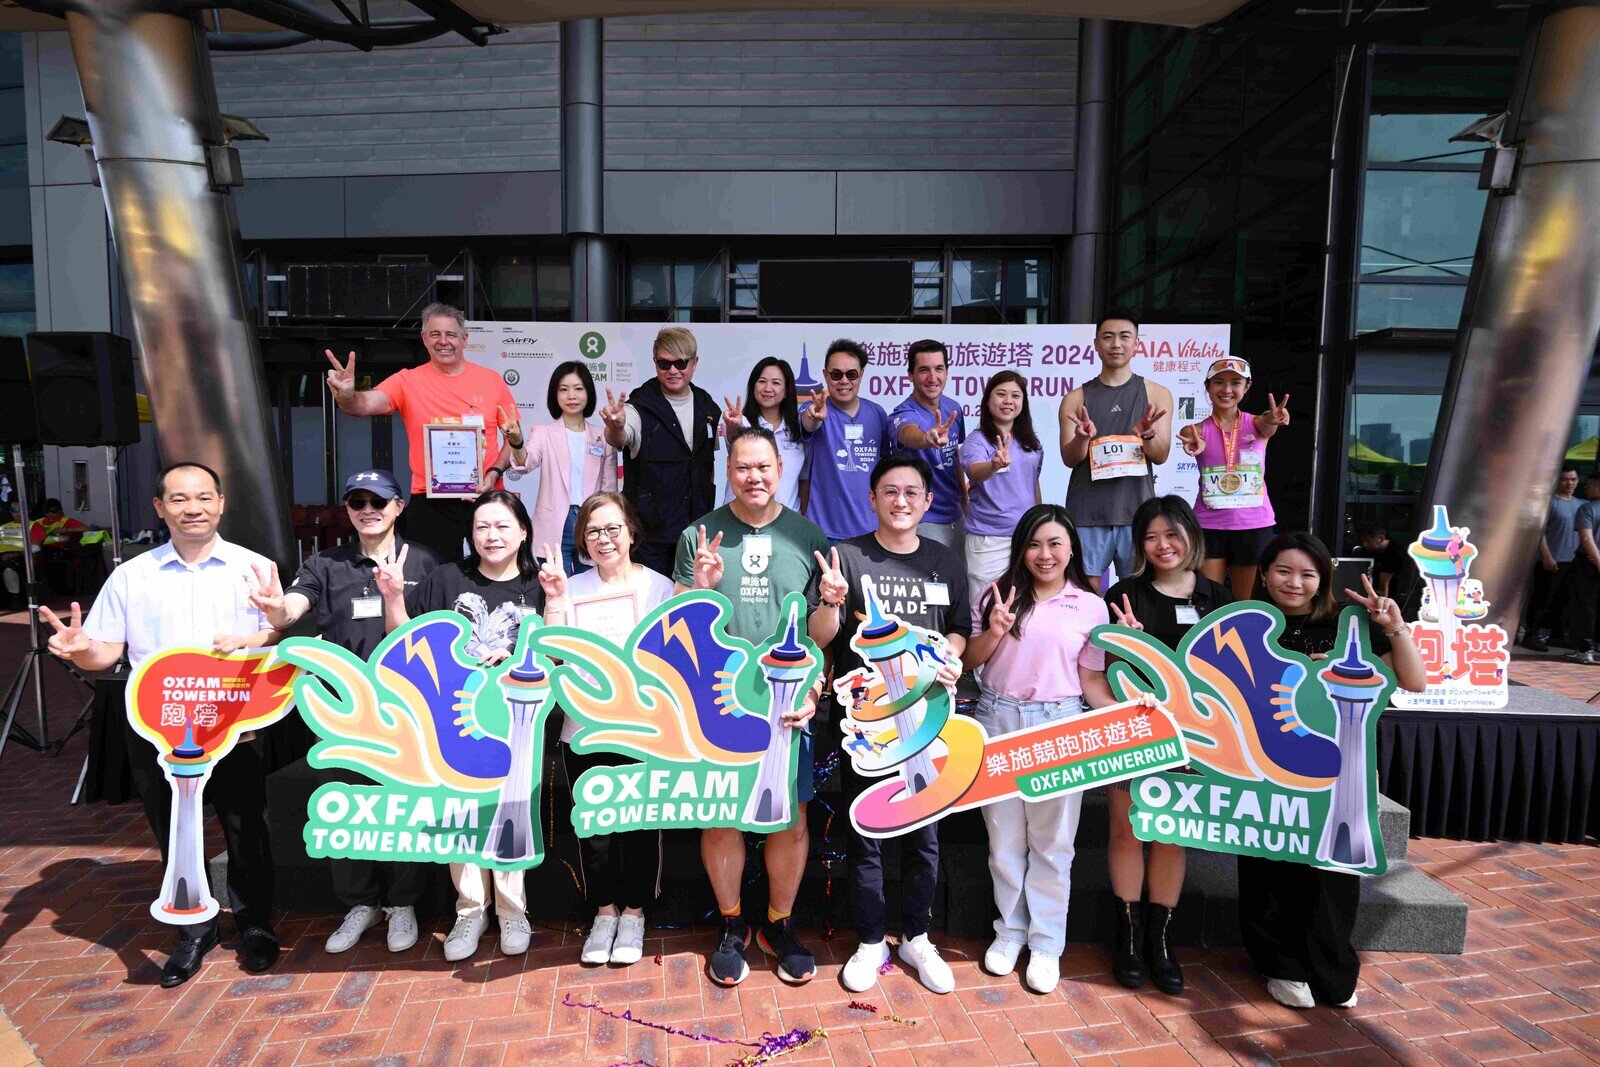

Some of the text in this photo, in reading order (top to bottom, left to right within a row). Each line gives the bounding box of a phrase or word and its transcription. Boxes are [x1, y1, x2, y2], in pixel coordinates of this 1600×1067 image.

[1041, 345, 1095, 366] 2024
[1132, 338, 1225, 358] AIA Vitality
[1153, 361, 1201, 373] 健康程式
[869, 375, 911, 396] OXF
[1103, 444, 1124, 455] L01
[740, 587, 769, 596] OXFAM
[880, 600, 928, 614] MADE
[163, 677, 220, 688] OXFAM
[162, 690, 250, 702] TOWERRUN
[985, 714, 1153, 778] 樂施競跑旅遊塔
[1030, 742, 1178, 793] OXFAM TOWERRUN
[582, 770, 739, 804] OXFAM
[316, 790, 479, 828] OXFAM
[1139, 776, 1310, 828] OXFAM
[580, 802, 738, 830] TOWERRUN
[312, 828, 478, 855] TOWERRUN
[1137, 811, 1310, 855] TOWERRUN
